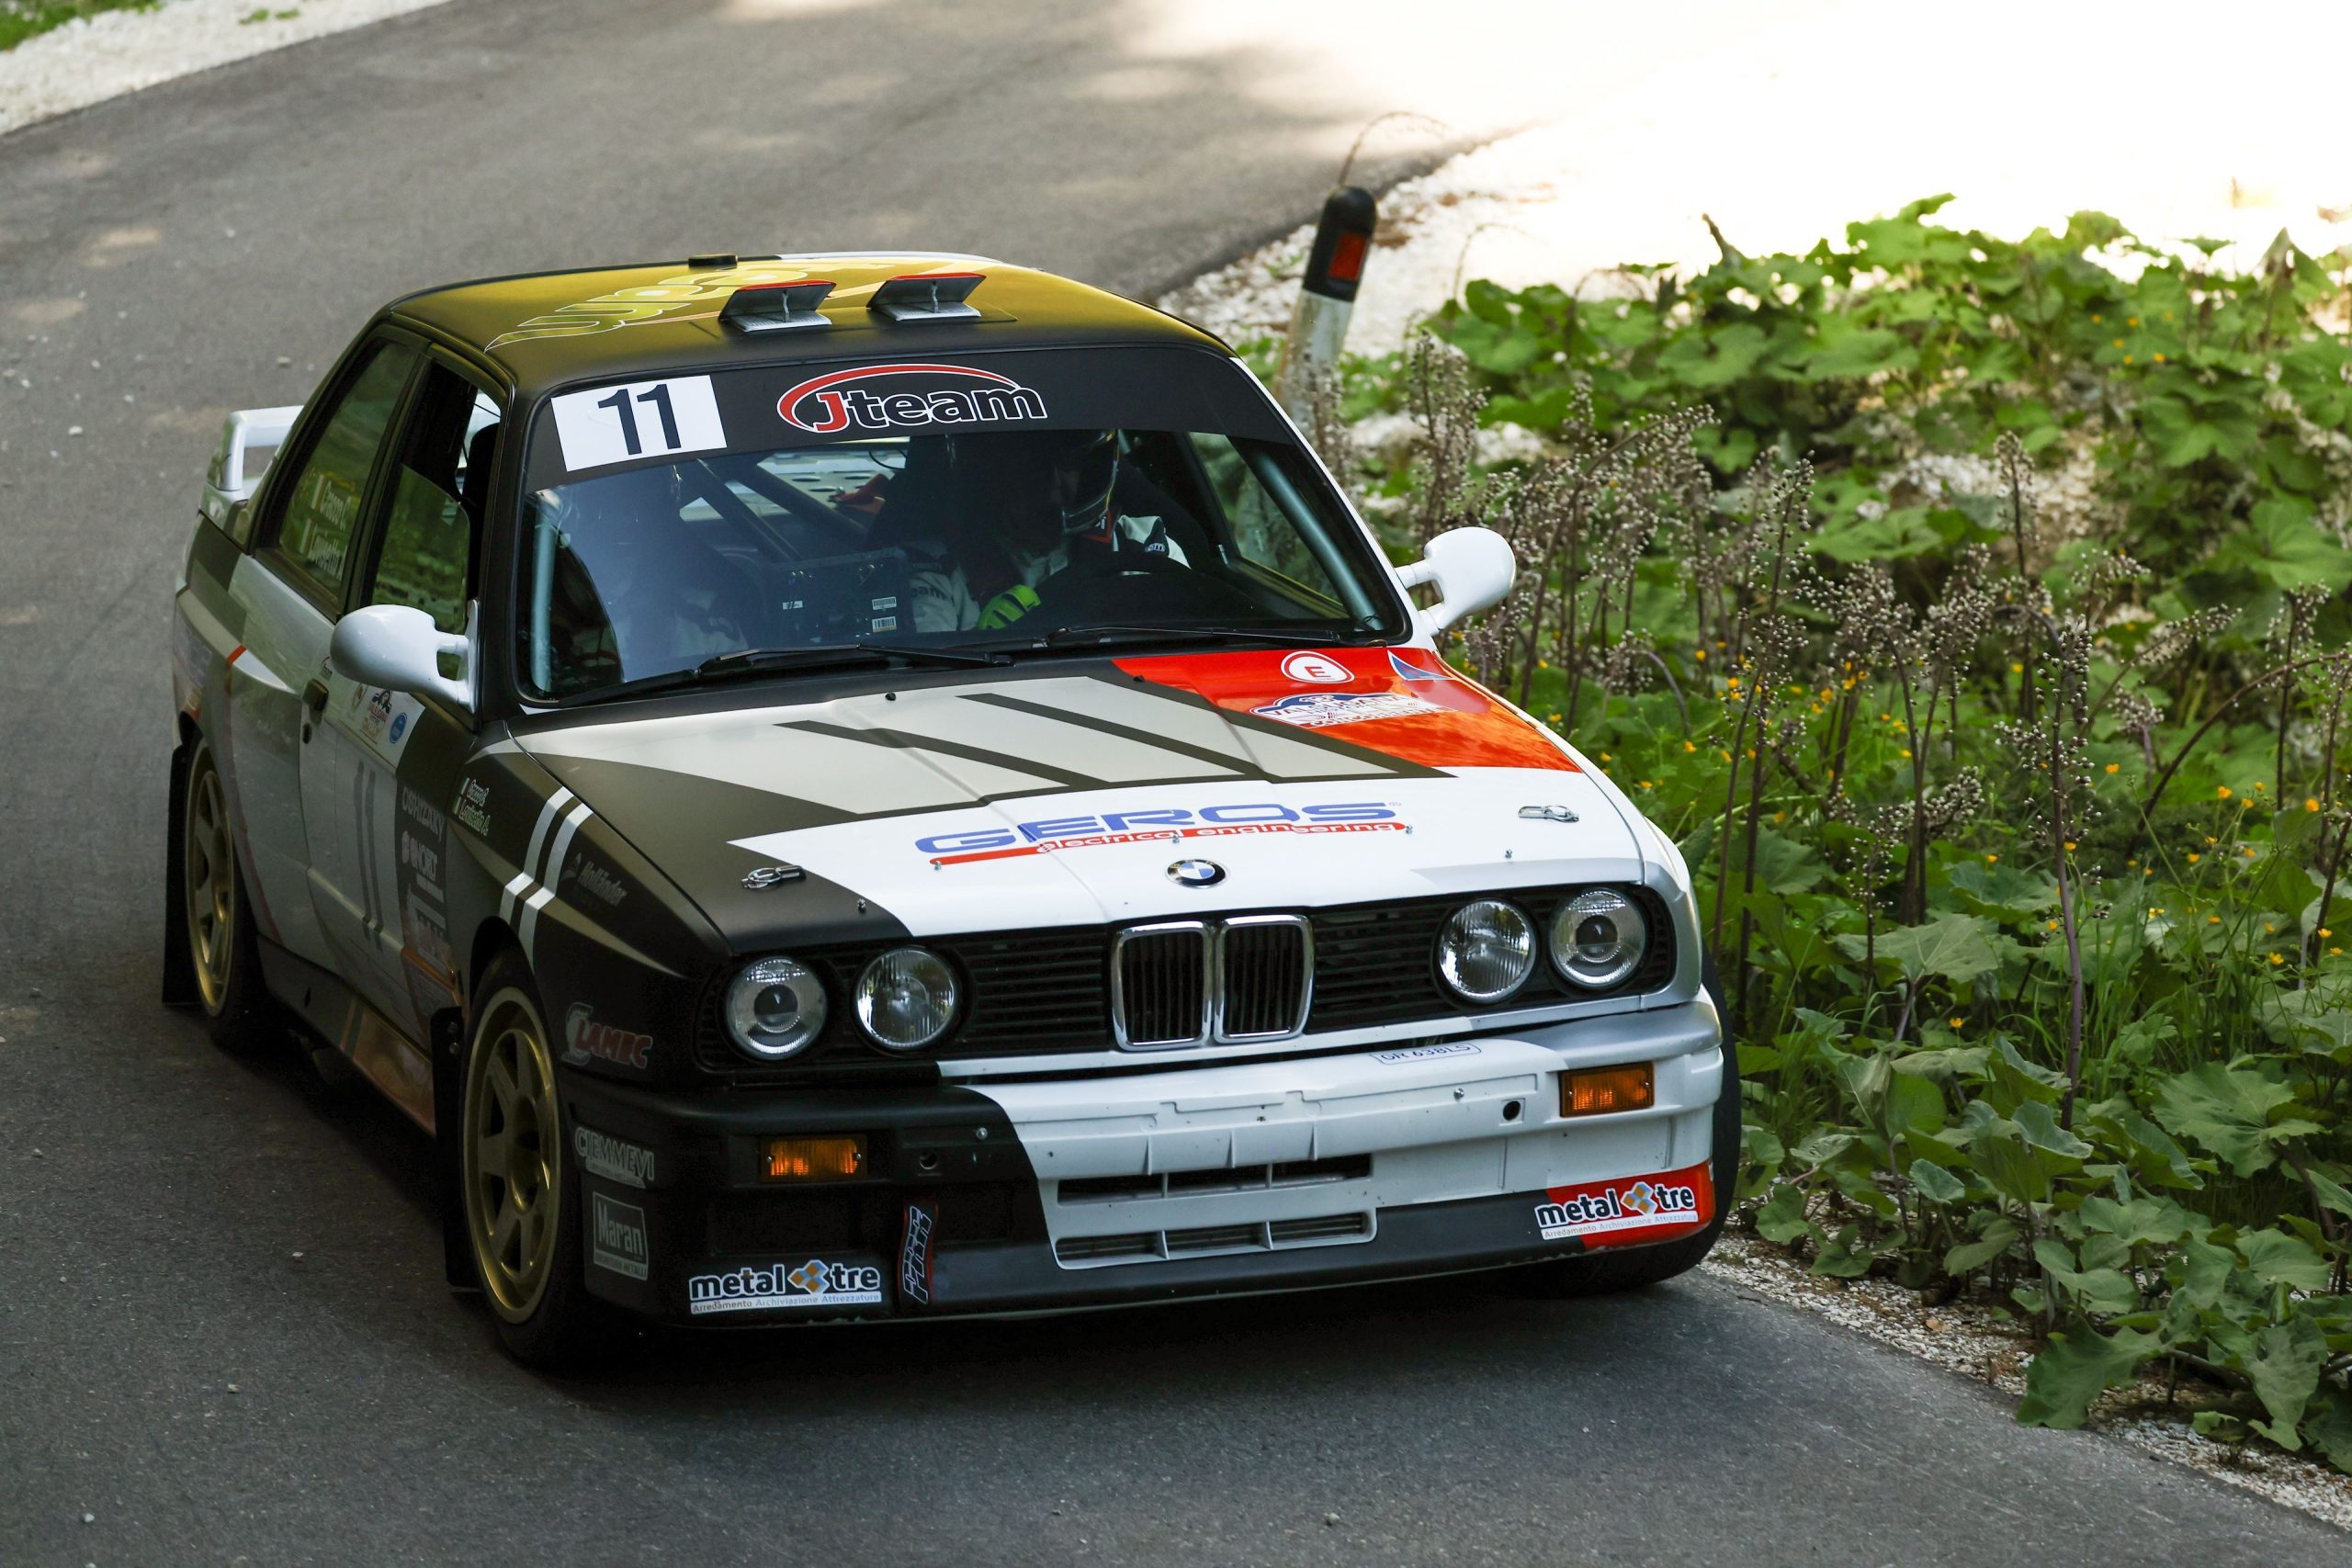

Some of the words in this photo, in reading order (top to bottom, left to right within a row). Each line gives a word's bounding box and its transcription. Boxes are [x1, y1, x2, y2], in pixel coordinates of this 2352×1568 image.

[597, 384, 681, 456] 11
[814, 387, 1047, 433] Jteam
[1305, 666, 1332, 678] E
[915, 802, 1396, 853] GEROS
[1036, 828, 1186, 854] electrical
[1195, 821, 1395, 840] engineering
[1534, 1188, 1623, 1228] metal
[1655, 1184, 1696, 1211] tre
[597, 1201, 644, 1256] Maran
[1544, 1224, 1597, 1239] Arredamento
[1600, 1217, 1652, 1231] Archiviazione
[689, 1264, 786, 1301] metal
[830, 1263, 881, 1291] tre
[693, 1300, 752, 1314] Arredamento
[755, 1296, 818, 1308] Archiviazione
[821, 1292, 879, 1304] Attrezzature
